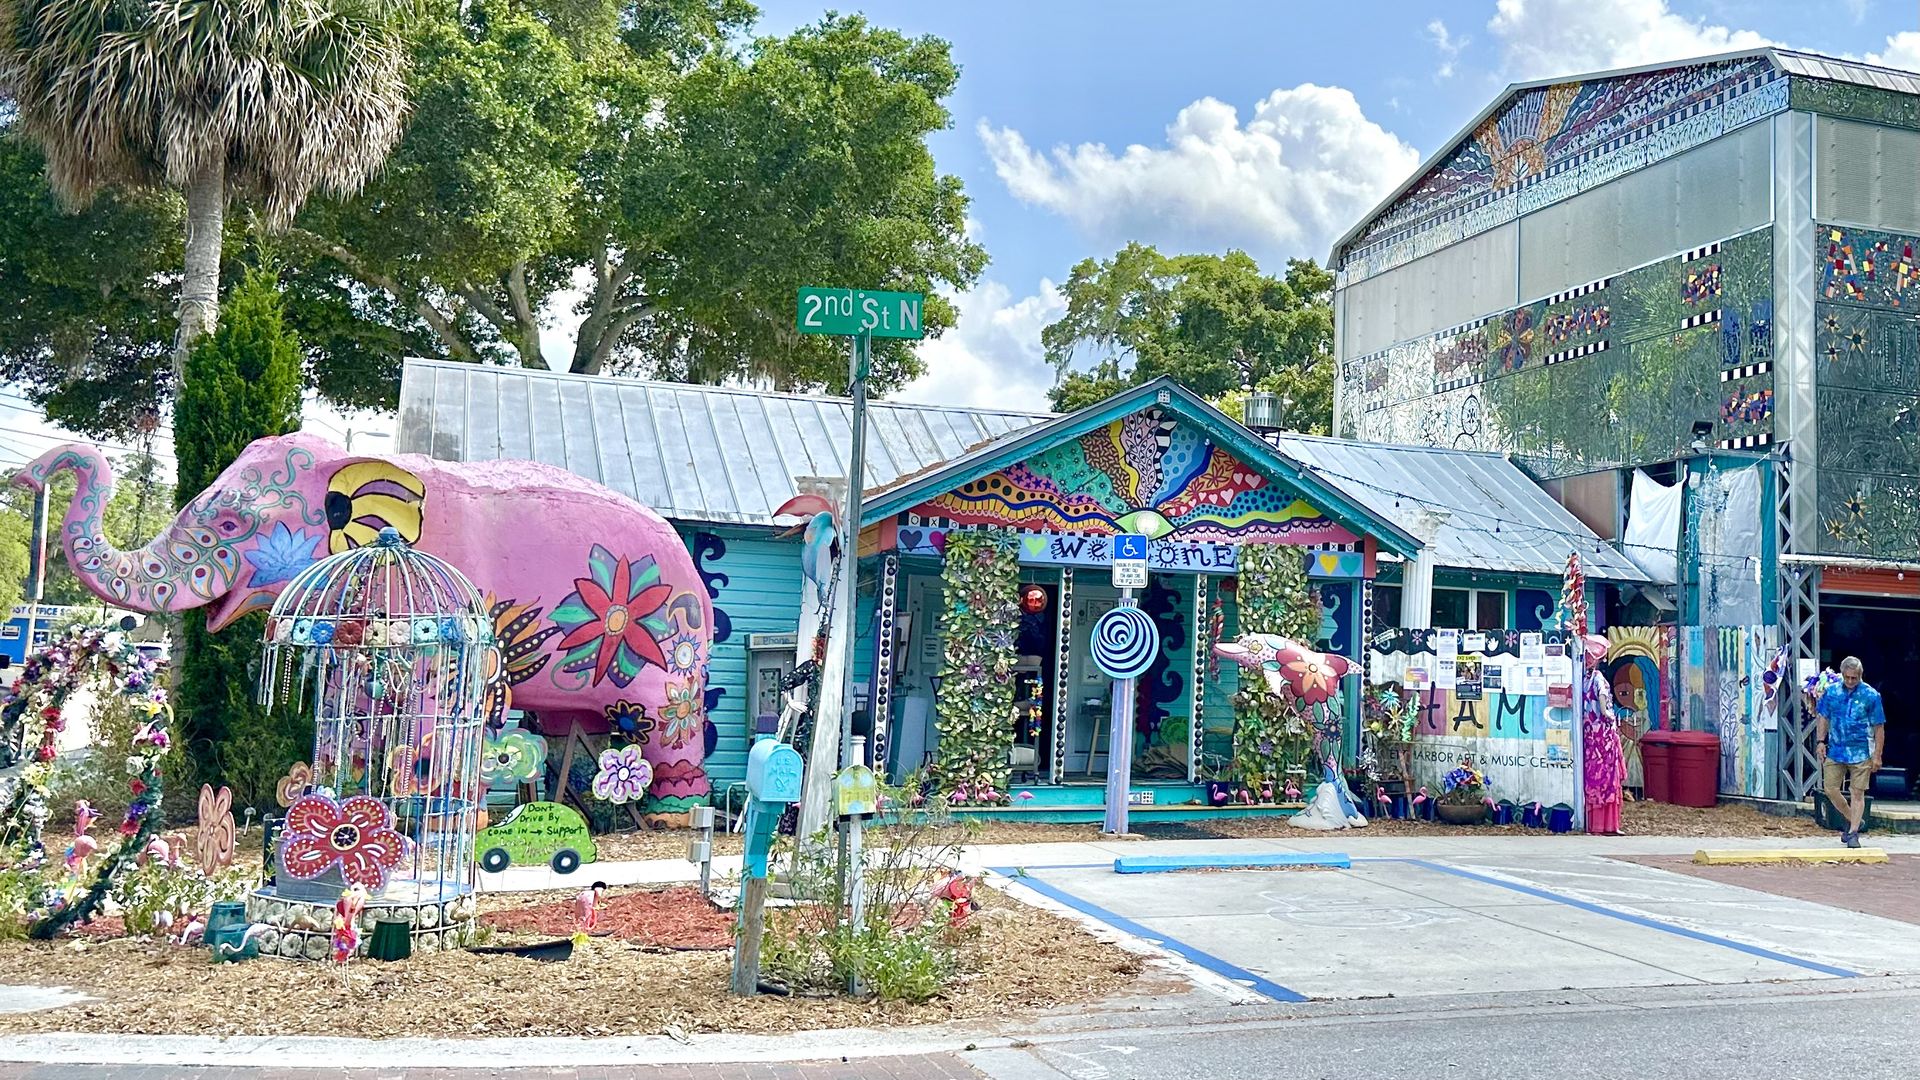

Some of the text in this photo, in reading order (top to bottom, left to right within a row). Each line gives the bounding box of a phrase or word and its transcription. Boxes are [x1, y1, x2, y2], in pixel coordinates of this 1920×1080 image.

[804, 289, 918, 331] 2nd St N
[1480, 755, 1487, 765] &
[1491, 756, 1526, 767] MUSIC
[528, 803, 554, 813] Dont
[548, 812, 560, 824] By
